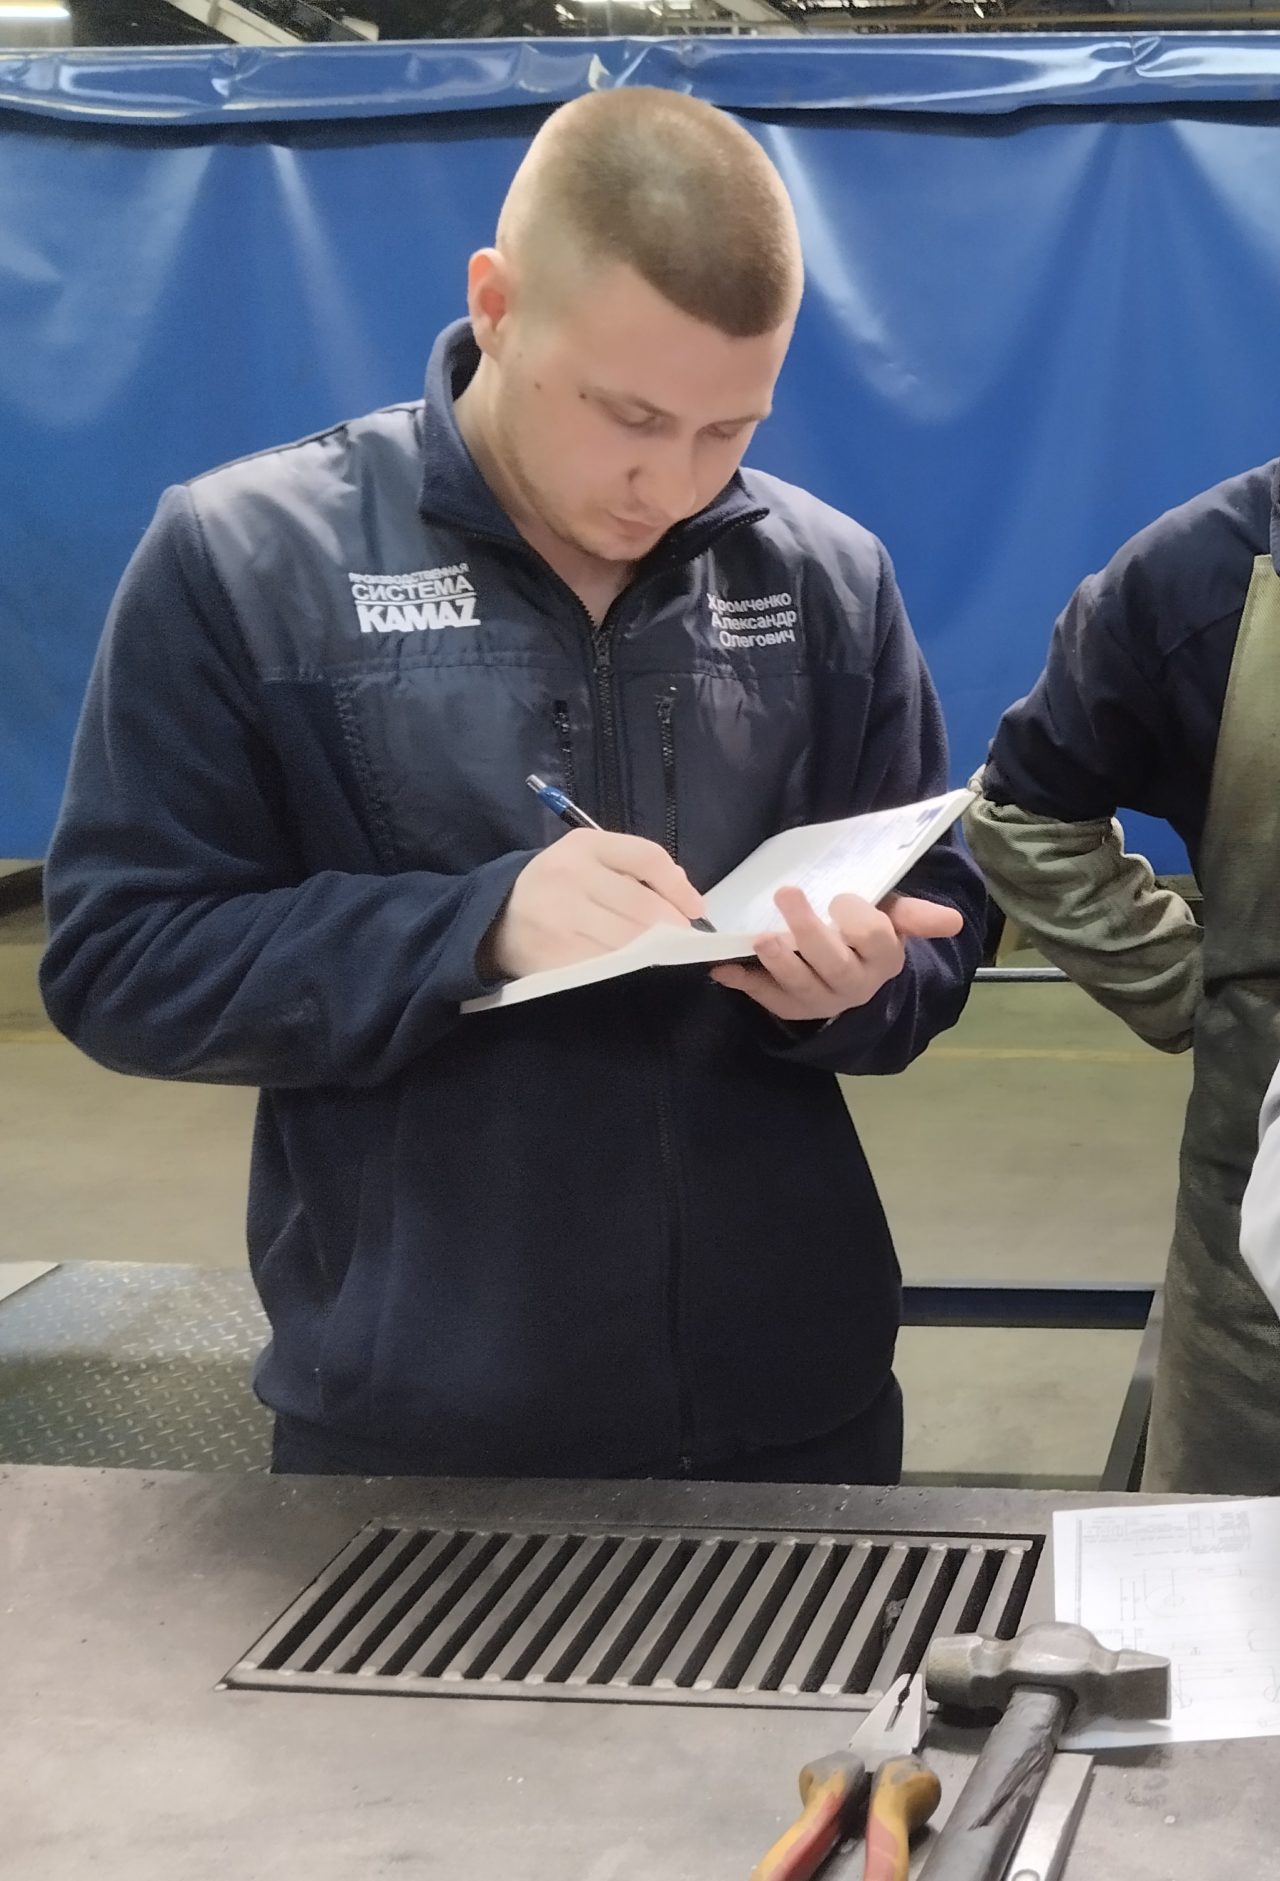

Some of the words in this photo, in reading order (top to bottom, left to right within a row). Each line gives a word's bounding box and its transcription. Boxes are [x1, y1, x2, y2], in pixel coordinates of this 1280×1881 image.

[351, 575, 475, 600] СИСТЕМА
[356, 597, 481, 633] KAMAZ
[706, 592, 792, 615] Хромченко
[711, 610, 797, 630] Александр
[719, 629, 796, 648] Олегович
